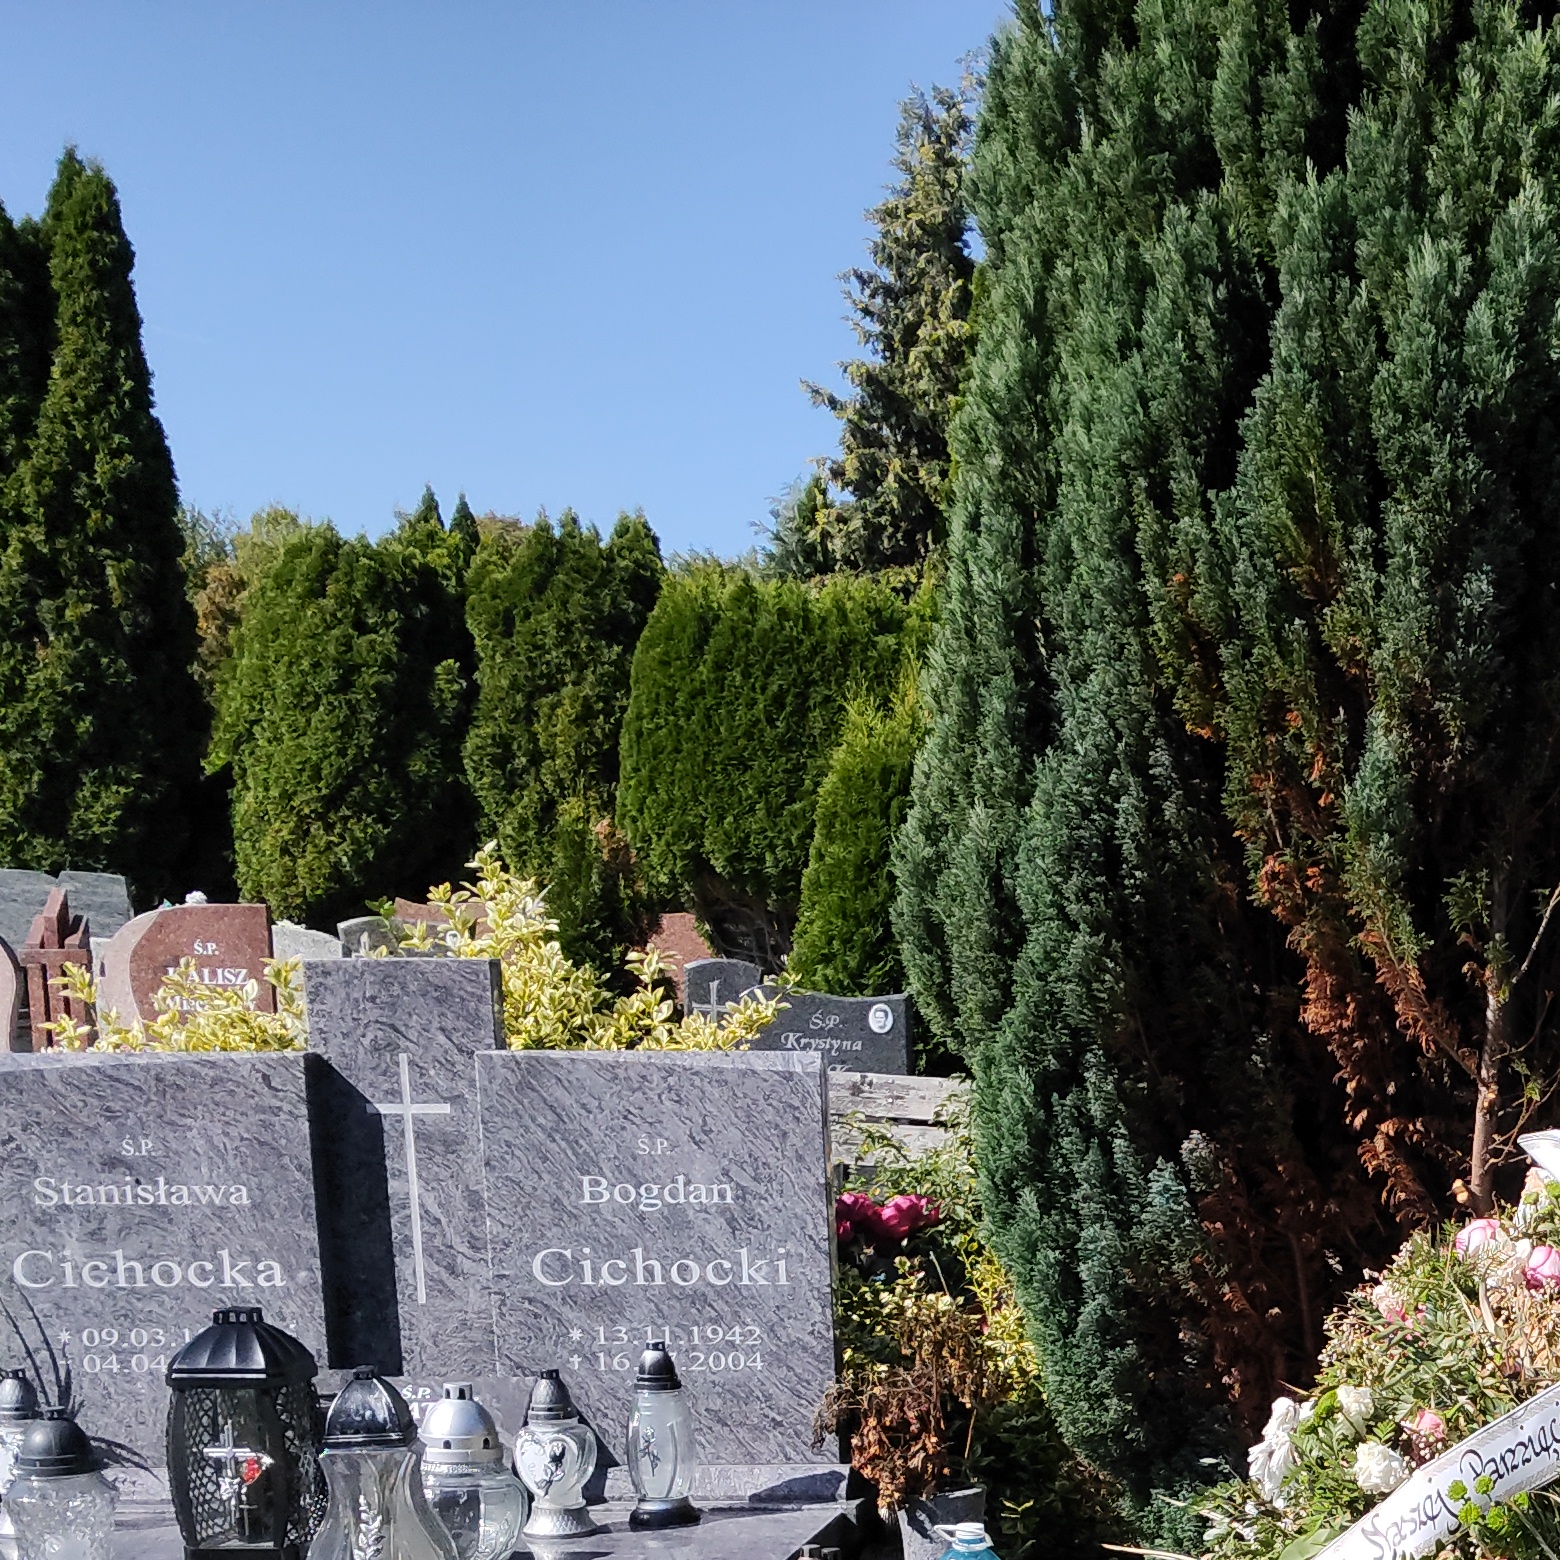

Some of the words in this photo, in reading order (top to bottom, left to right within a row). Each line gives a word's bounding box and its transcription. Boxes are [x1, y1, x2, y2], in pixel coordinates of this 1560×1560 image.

[193, 939, 219, 955] Ś.P.
[780, 1032, 863, 1056] Krystyna
[33, 1175, 251, 1207] Stanisława
[580, 1174, 734, 1213] Bogdan
[12, 1248, 287, 1290] Cichocka
[532, 1246, 791, 1287] Cichocki
[596, 1325, 763, 1346] 13.11.1942
